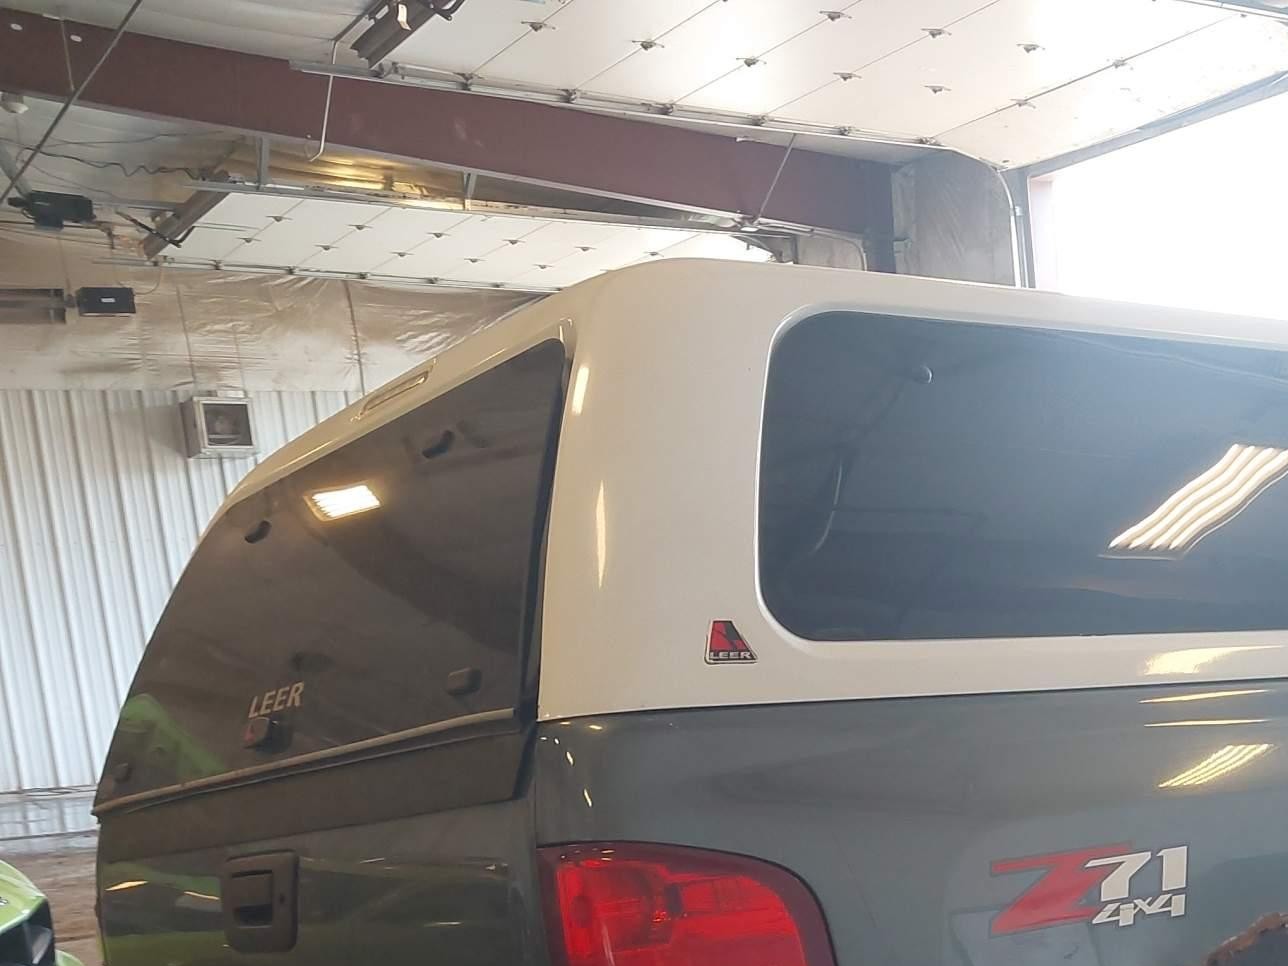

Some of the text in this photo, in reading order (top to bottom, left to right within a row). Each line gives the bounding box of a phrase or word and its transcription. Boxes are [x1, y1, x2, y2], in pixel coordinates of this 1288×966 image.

[709, 651, 751, 660] LEER
[248, 681, 305, 718] LEER
[989, 843, 1188, 936] Z71
